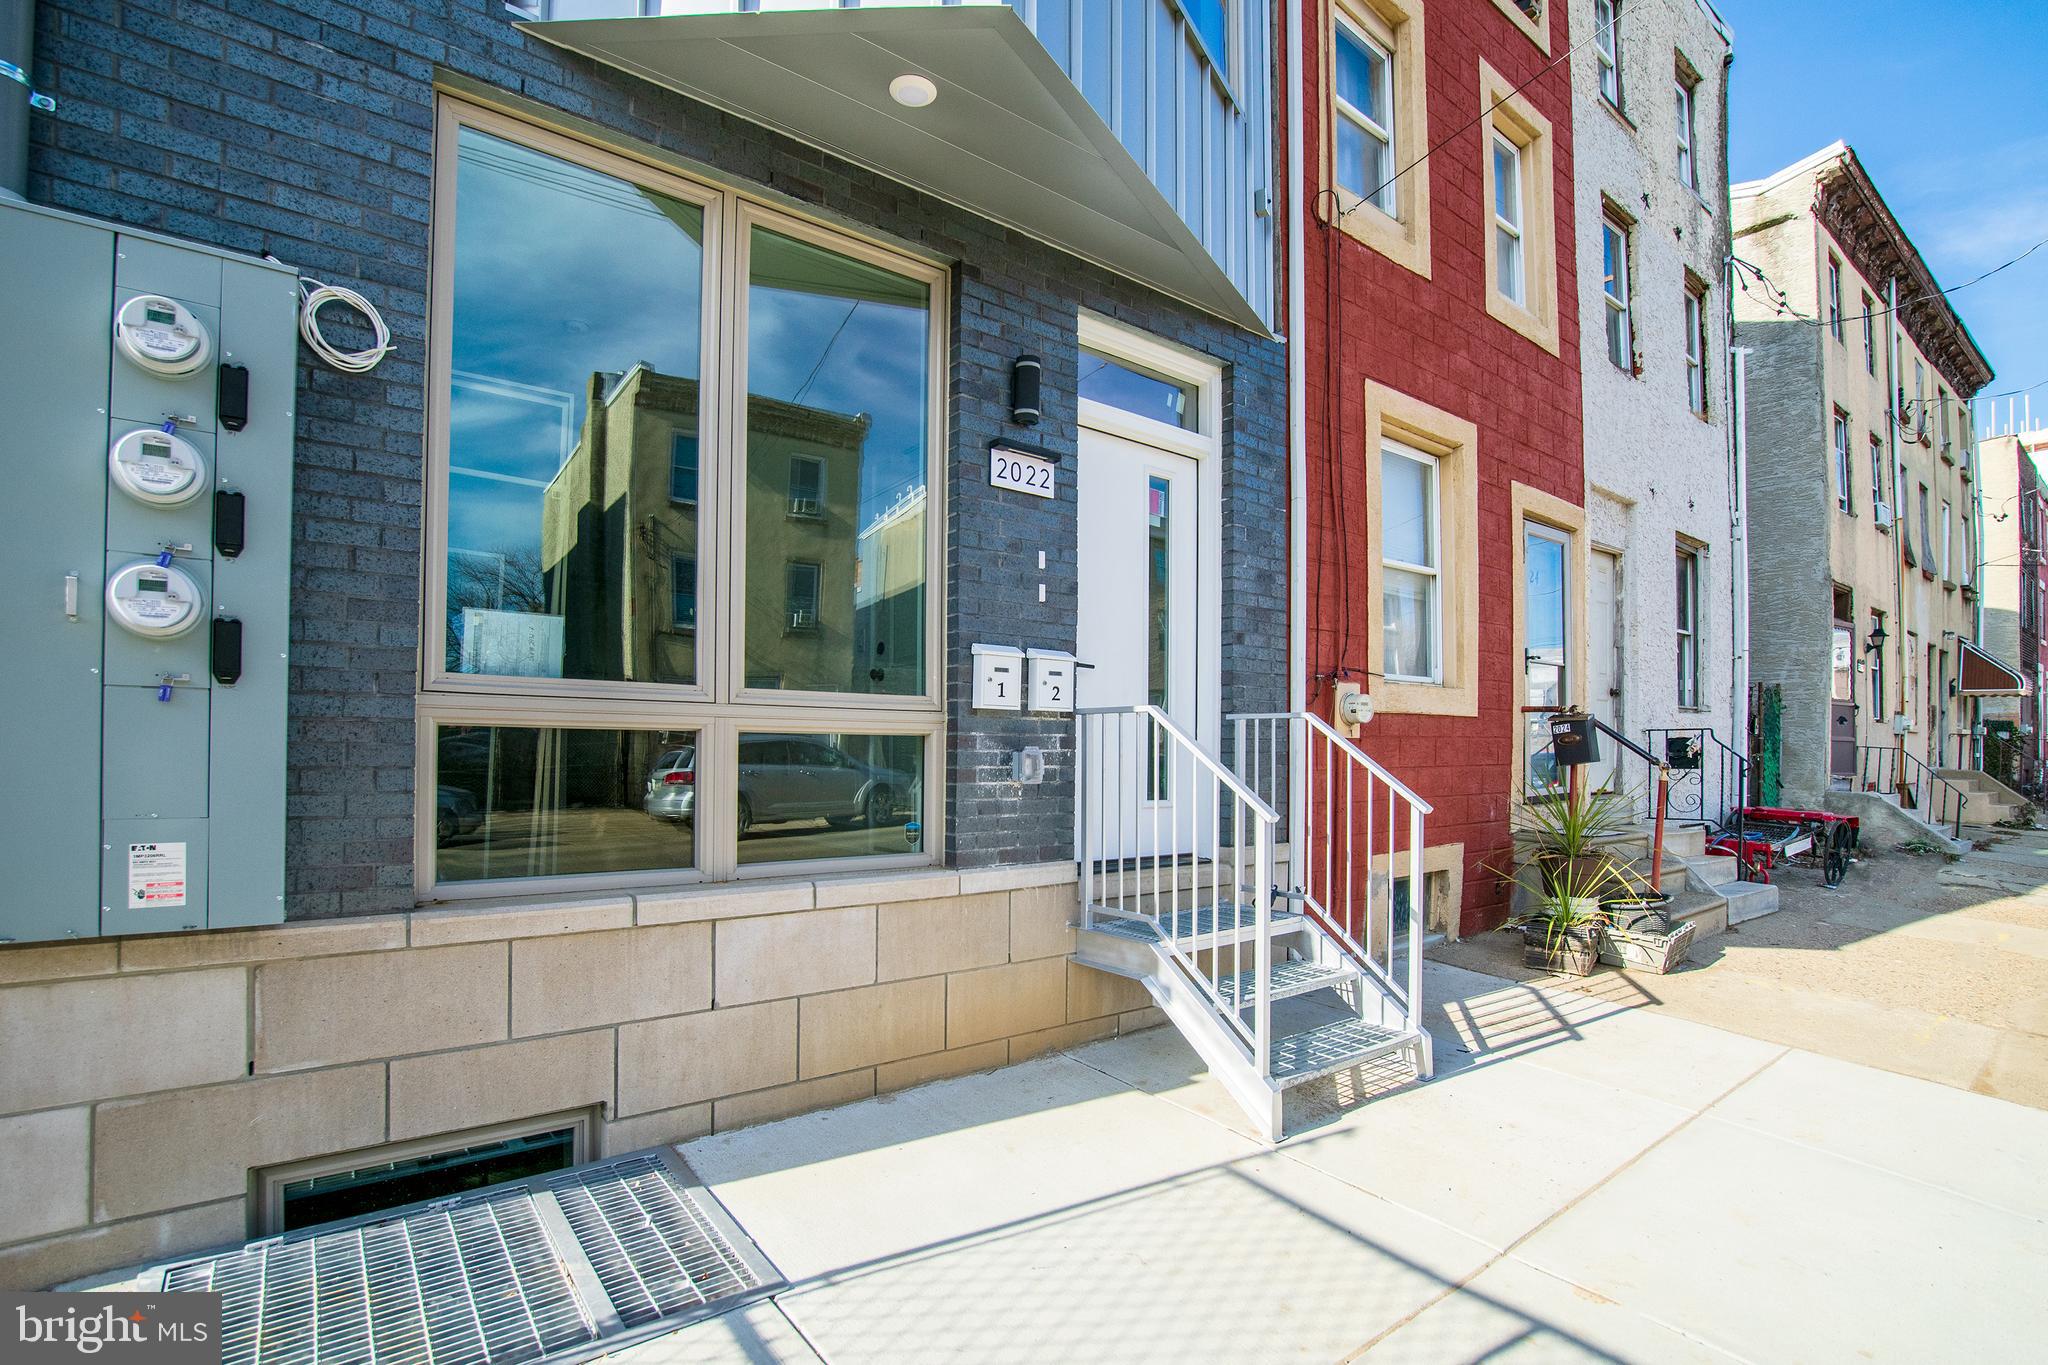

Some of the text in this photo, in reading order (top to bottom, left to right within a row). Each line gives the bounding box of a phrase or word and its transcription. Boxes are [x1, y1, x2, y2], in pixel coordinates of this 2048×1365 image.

[996, 457, 1050, 490] 2022
[997, 682, 1006, 698] 1
[1051, 685, 1061, 701] 2
[1553, 724, 1570, 734] 2024
